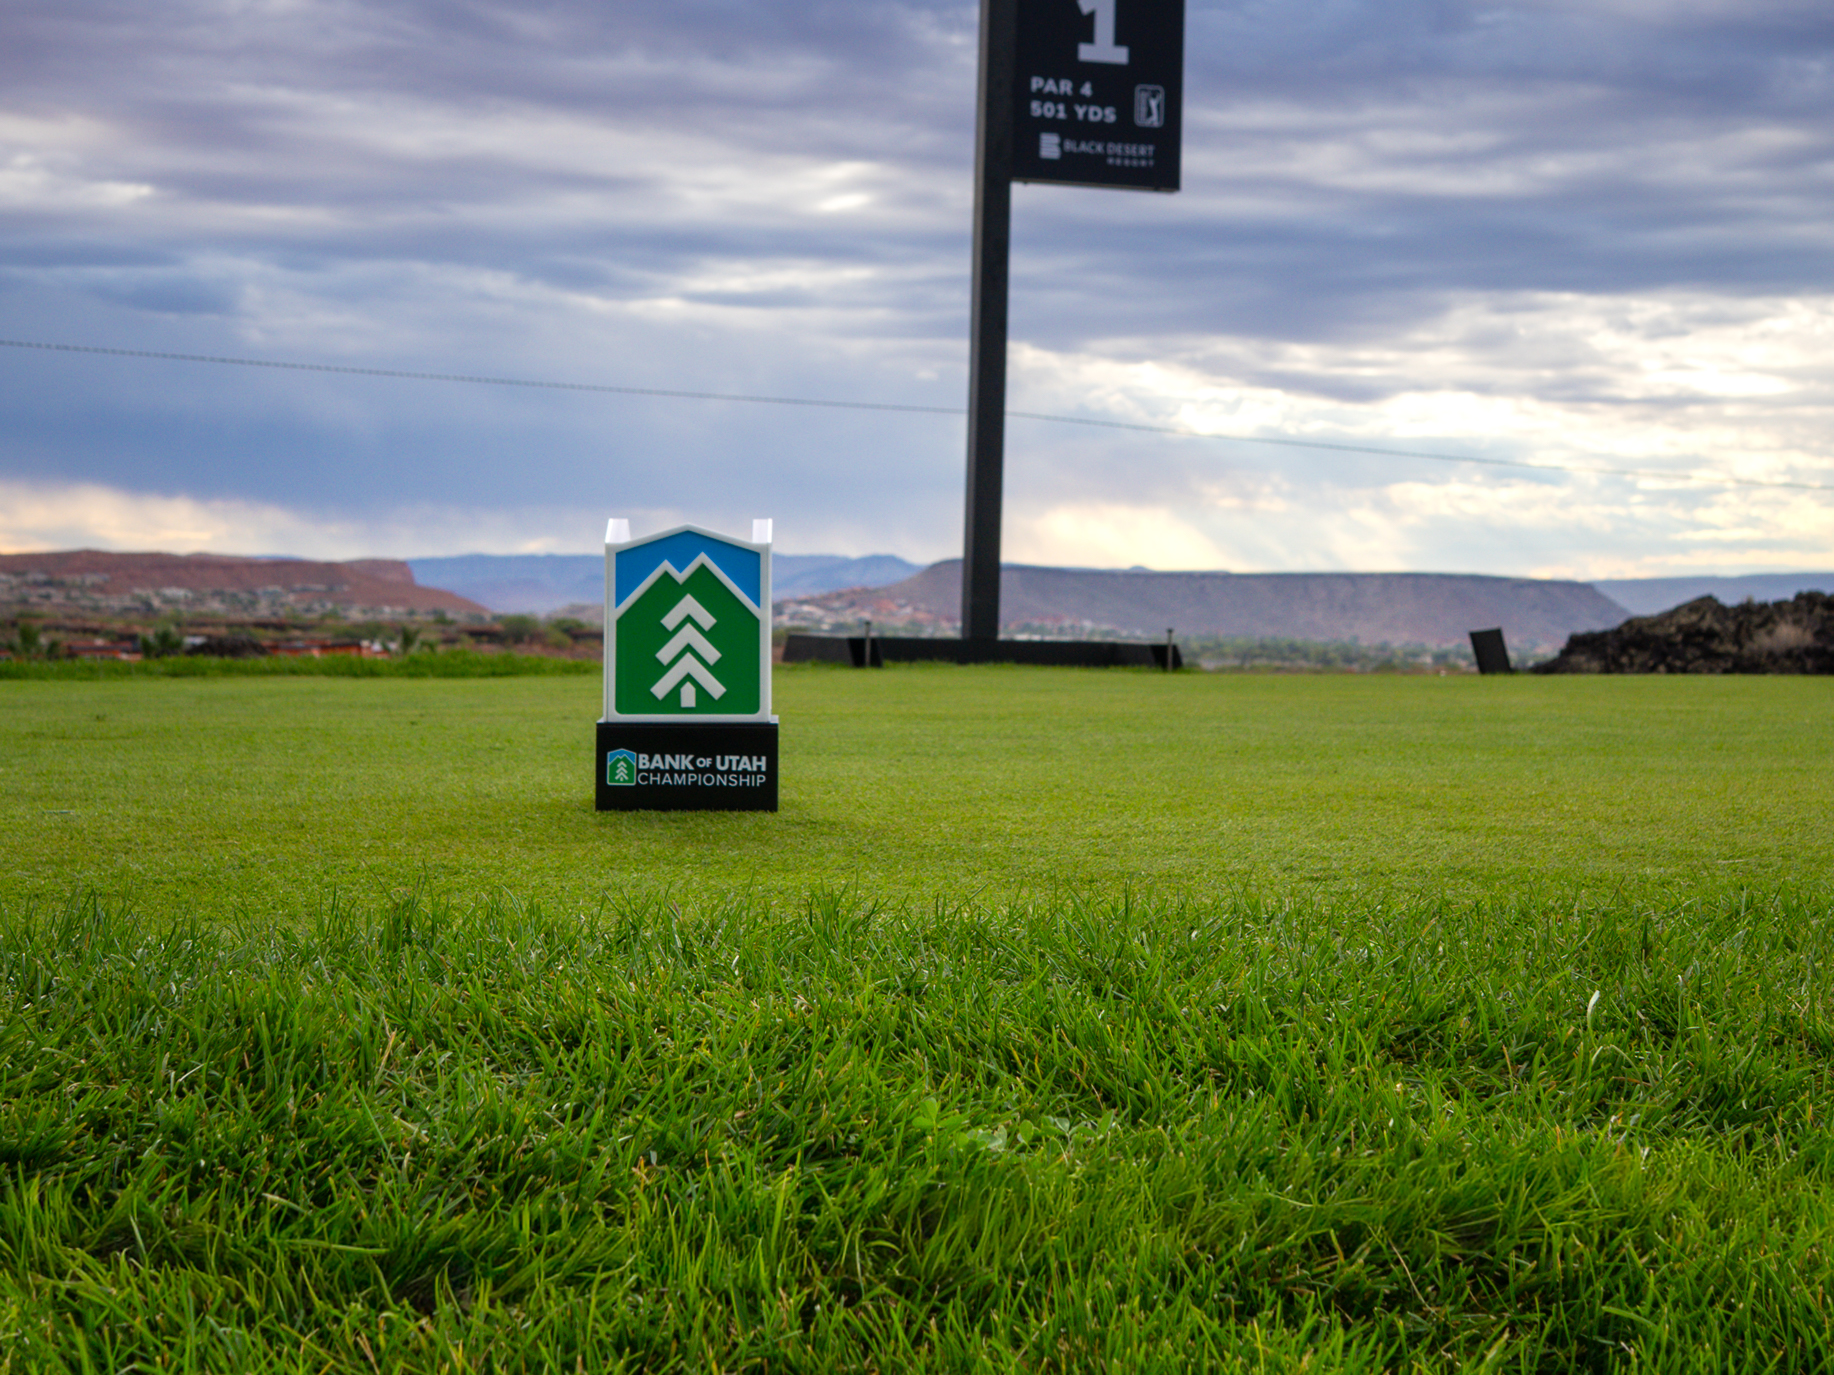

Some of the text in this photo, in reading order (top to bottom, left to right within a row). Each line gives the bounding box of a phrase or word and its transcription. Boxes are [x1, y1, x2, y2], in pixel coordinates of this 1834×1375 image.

[1030, 76, 1093, 97] PAR 4
[1030, 100, 1067, 119] 501
[1073, 104, 1117, 123] YDS
[1063, 138, 1155, 157] BLACK DESERT
[638, 754, 767, 771] BANK OF UTAH
[637, 772, 766, 787] CHAMPIONSHIP
